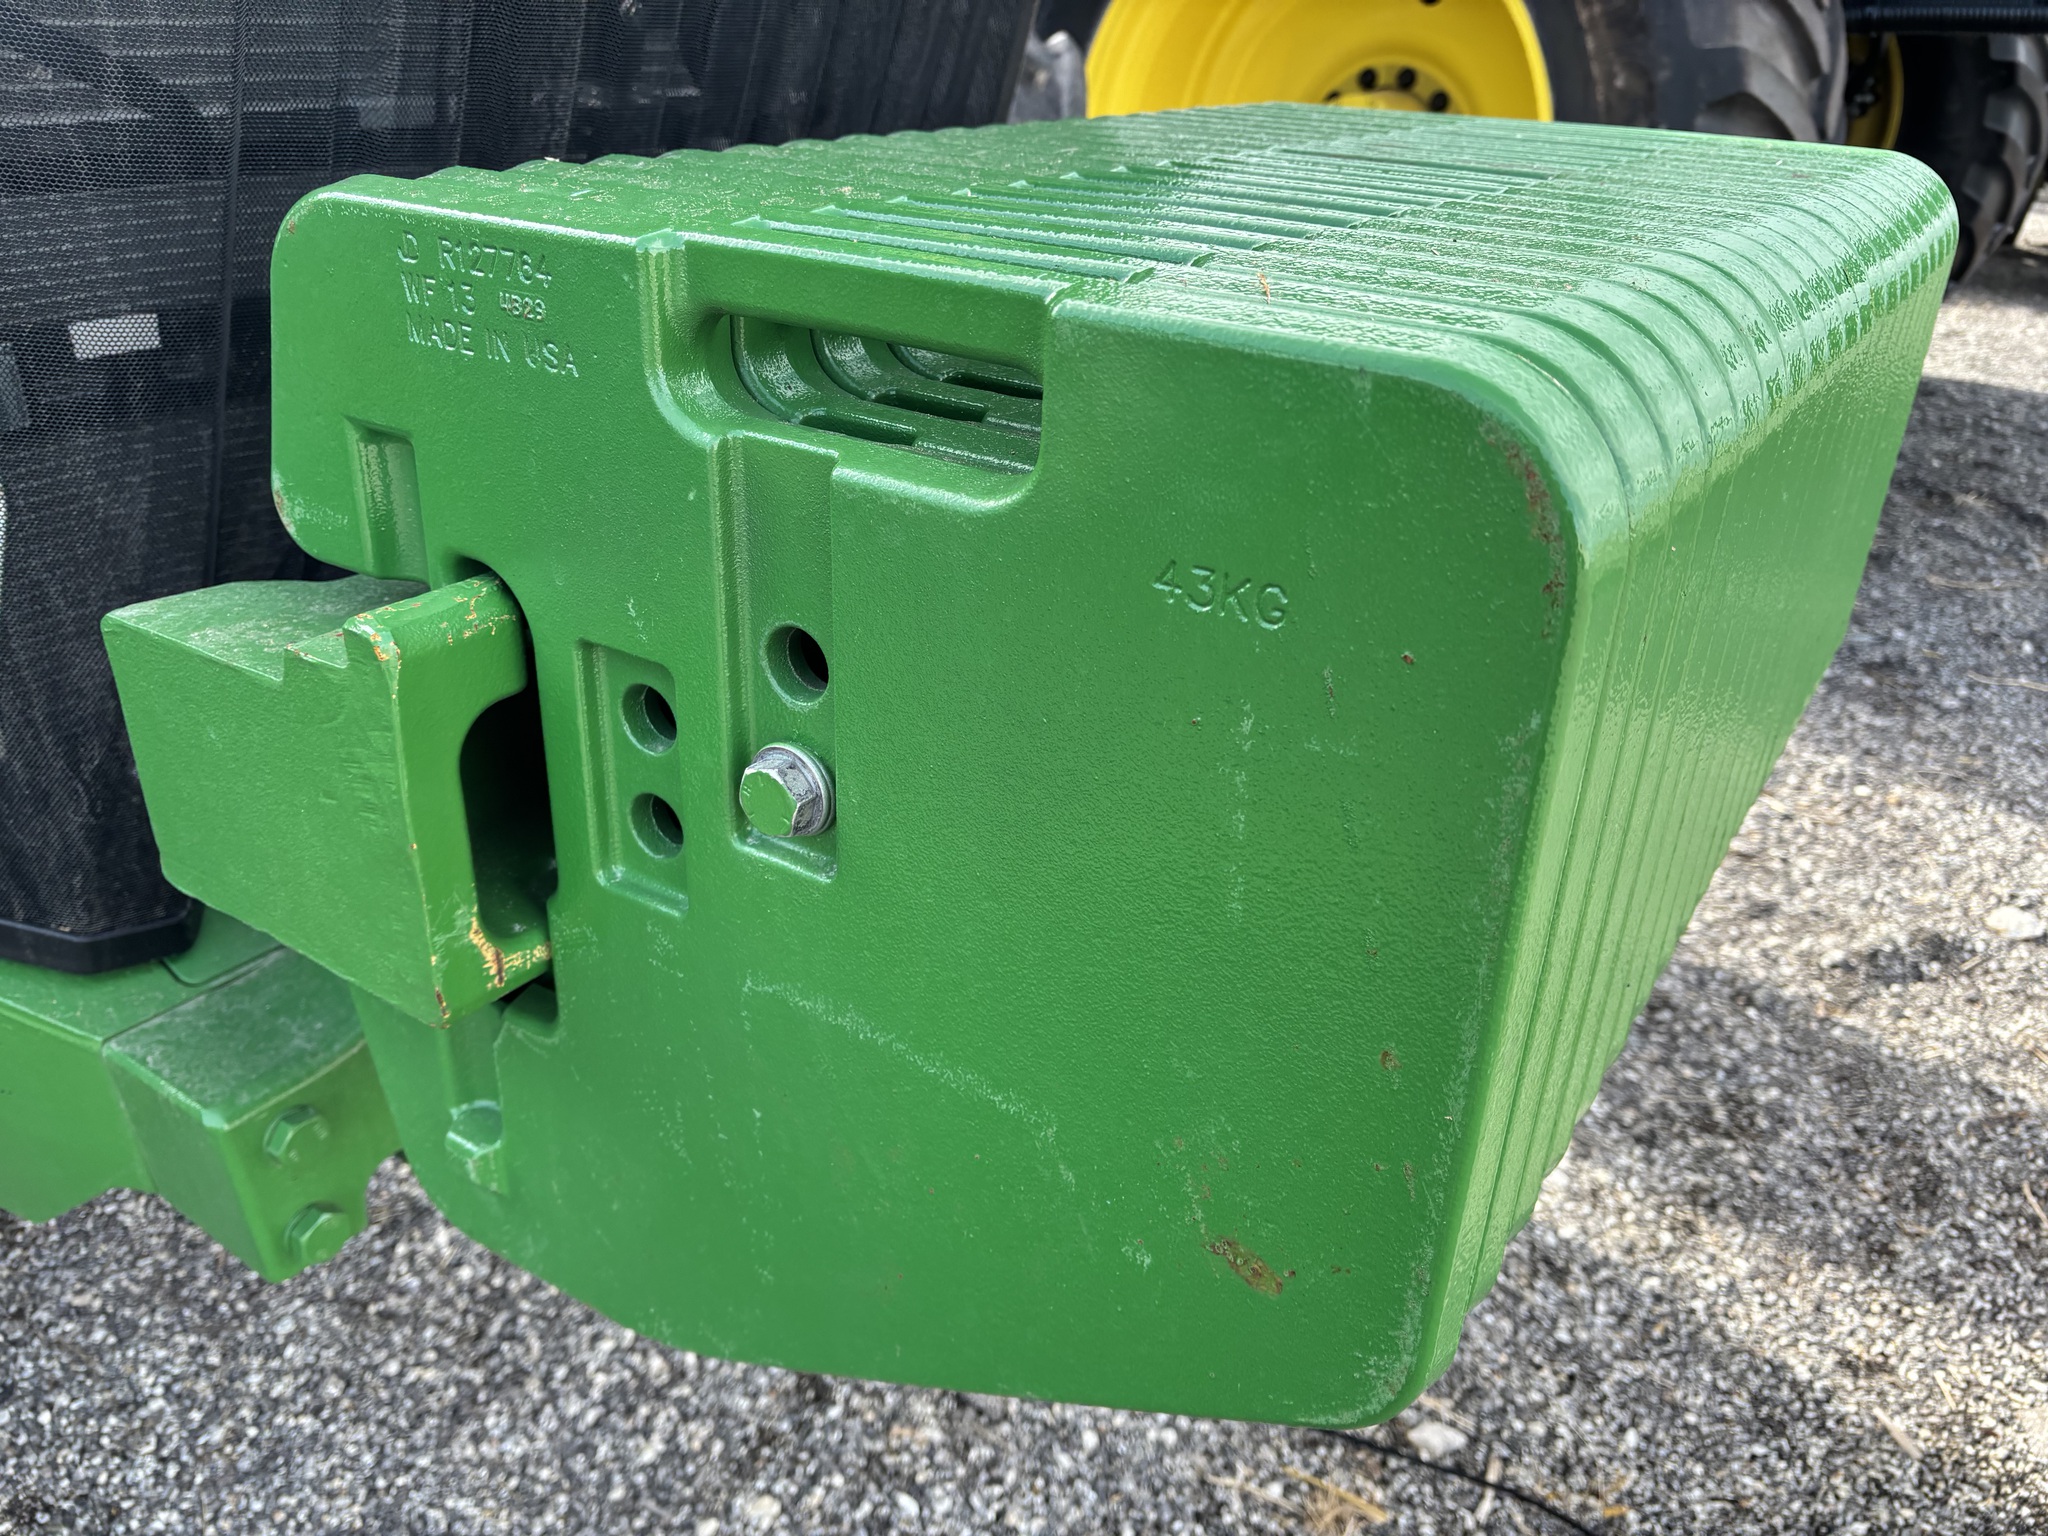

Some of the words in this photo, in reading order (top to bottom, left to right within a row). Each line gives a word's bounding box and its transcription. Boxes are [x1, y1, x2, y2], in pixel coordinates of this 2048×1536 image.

[401, 271, 436, 306] WF
[406, 312, 475, 356] MADE
[486, 328, 510, 363] IN
[523, 334, 579, 378] USA
[1151, 559, 1288, 631] 43KG
